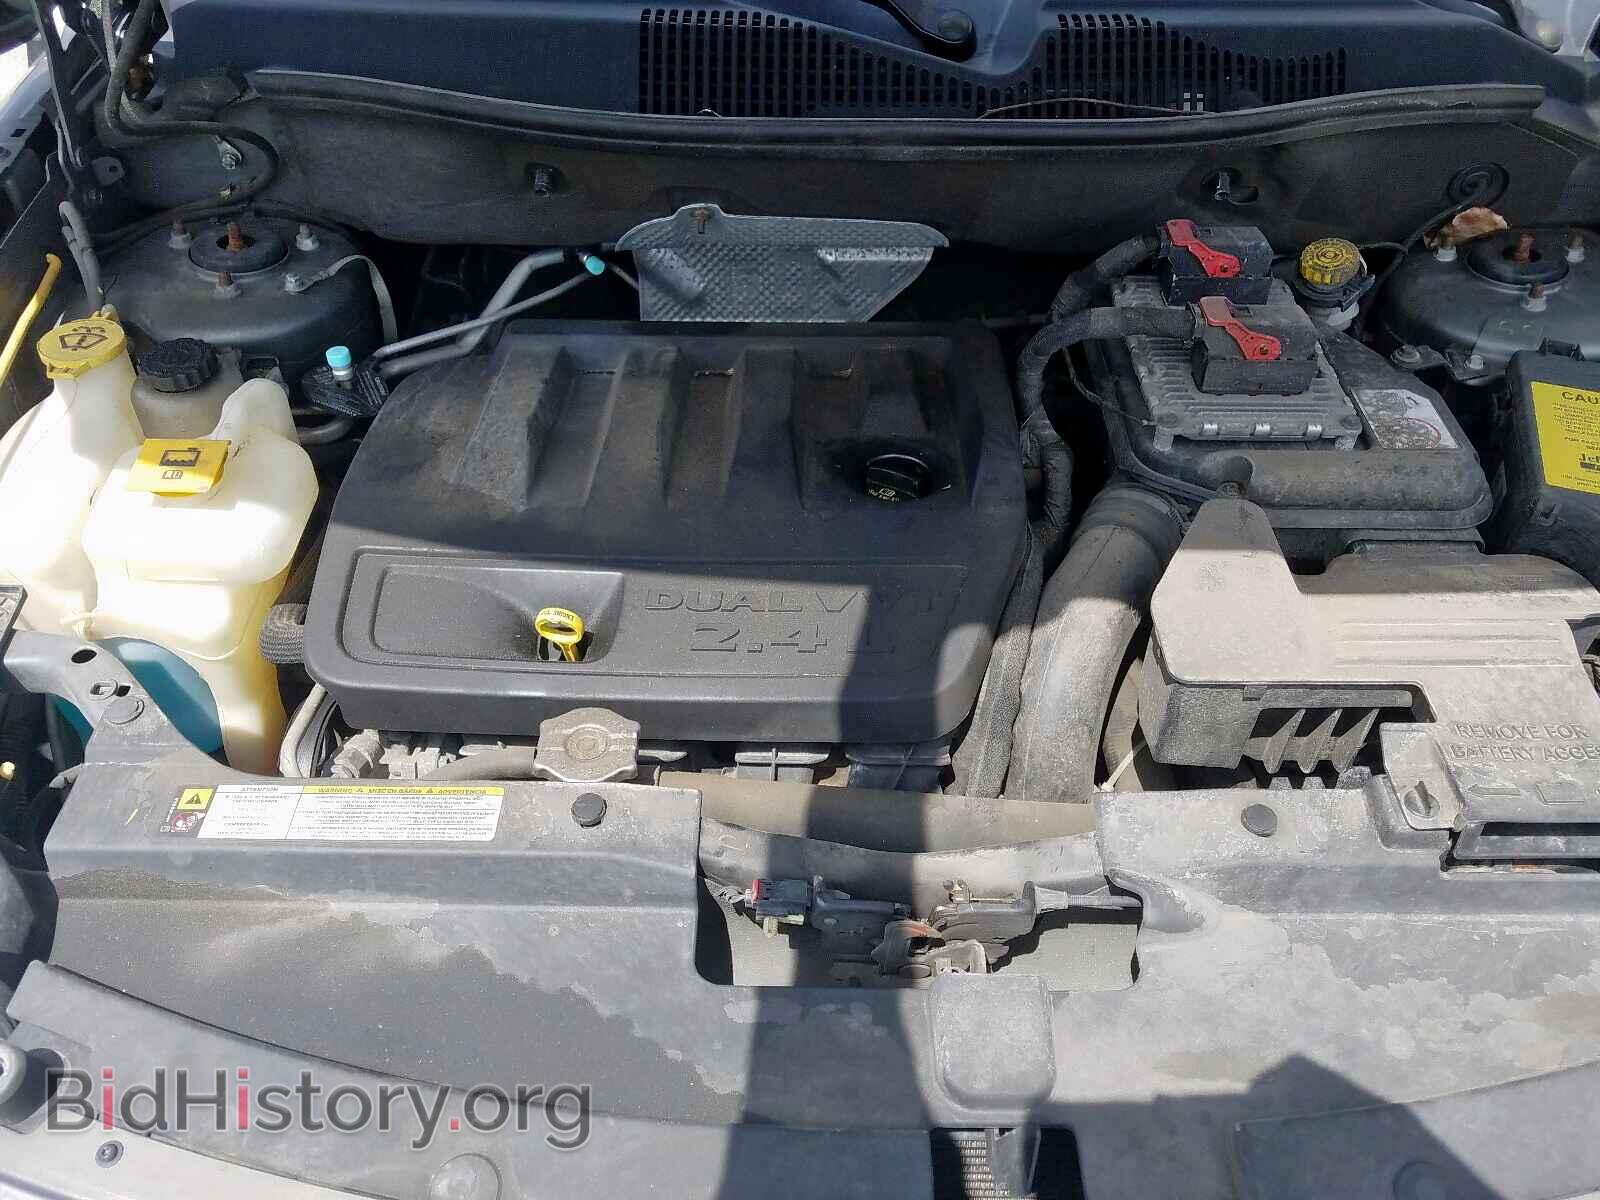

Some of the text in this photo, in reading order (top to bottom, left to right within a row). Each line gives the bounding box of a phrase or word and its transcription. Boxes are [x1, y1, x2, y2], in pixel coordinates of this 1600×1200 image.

[645, 588, 802, 613] DUAL
[1454, 722, 1591, 740] REMOVE FOR
[1450, 743, 1536, 761] BATTERY
